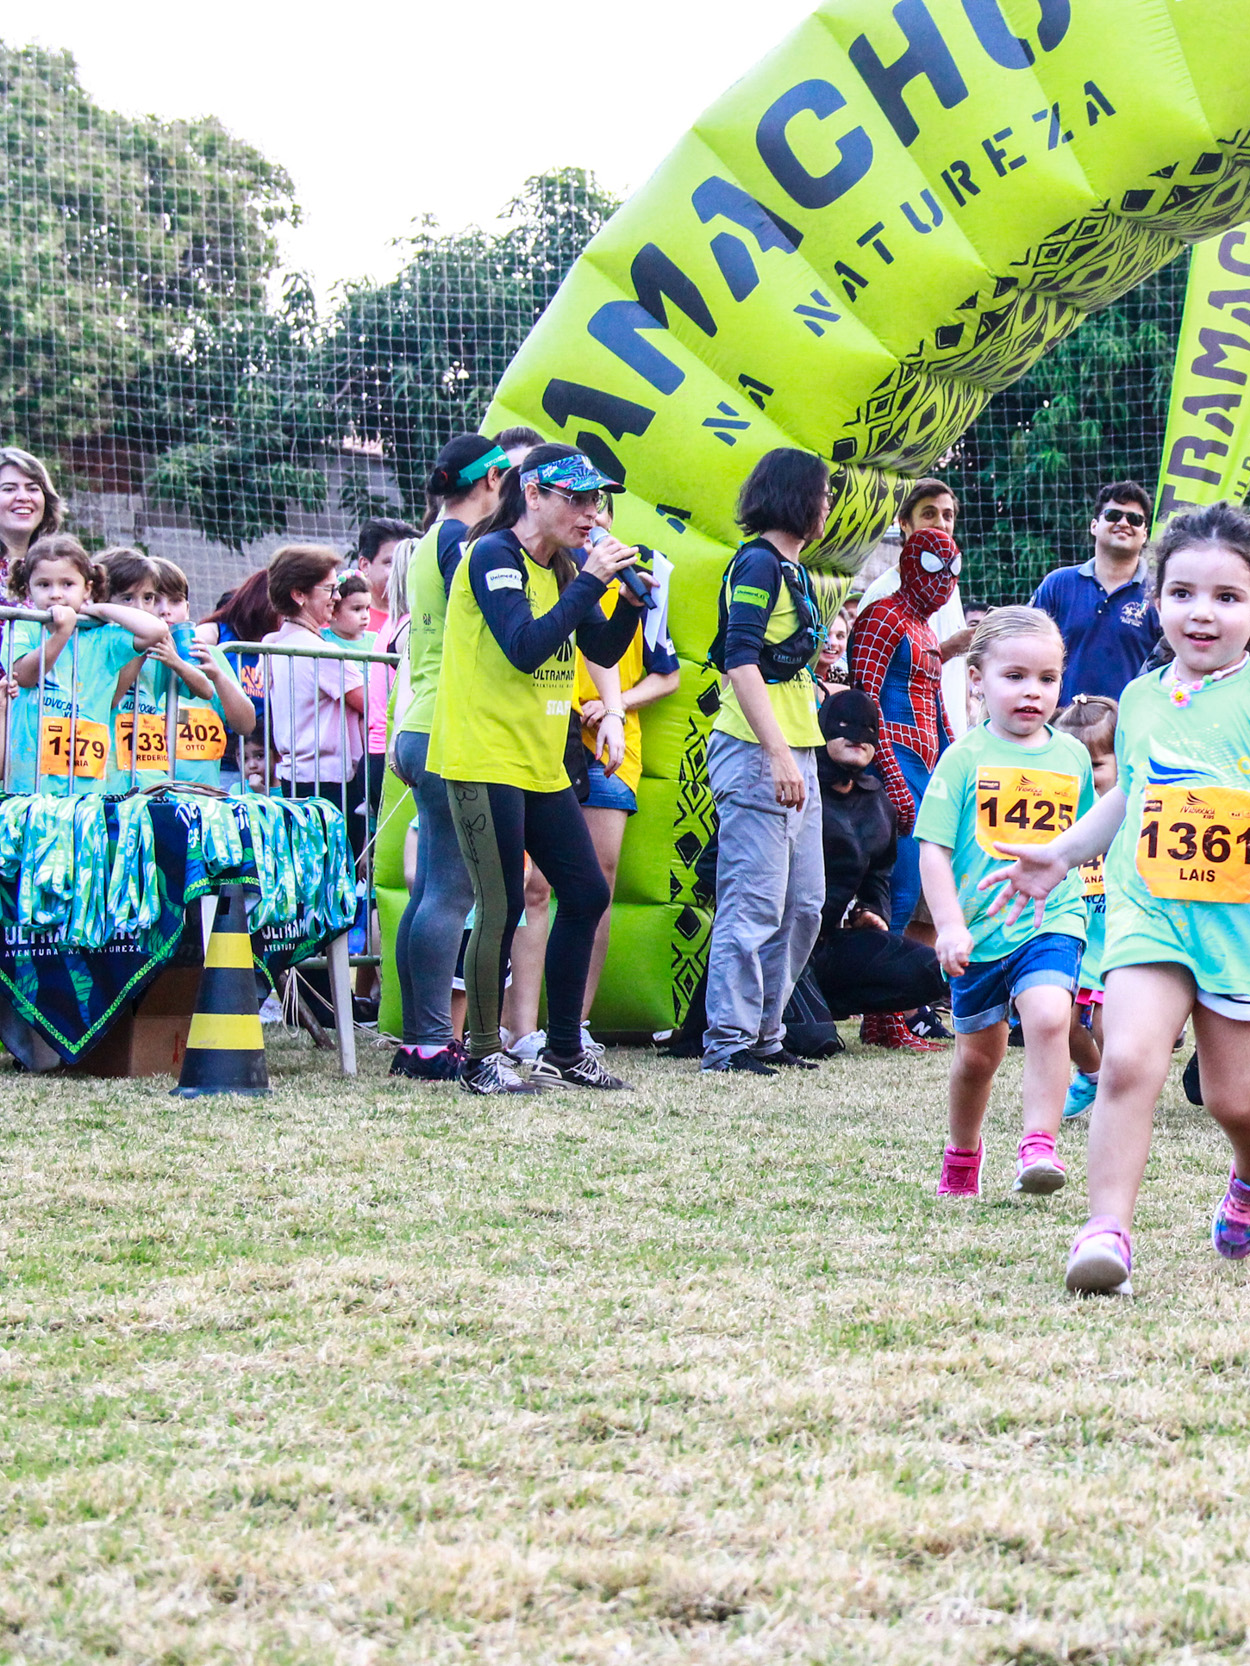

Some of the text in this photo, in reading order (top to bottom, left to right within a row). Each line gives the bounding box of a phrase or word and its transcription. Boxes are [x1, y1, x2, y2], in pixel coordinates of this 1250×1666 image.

[702, 80, 1117, 447] NA NATUREZA
[122, 732, 168, 752] 133
[980, 796, 1074, 833] 1425
[1179, 867, 1216, 883] LAIS
[5, 948, 59, 958] AVENTURA
